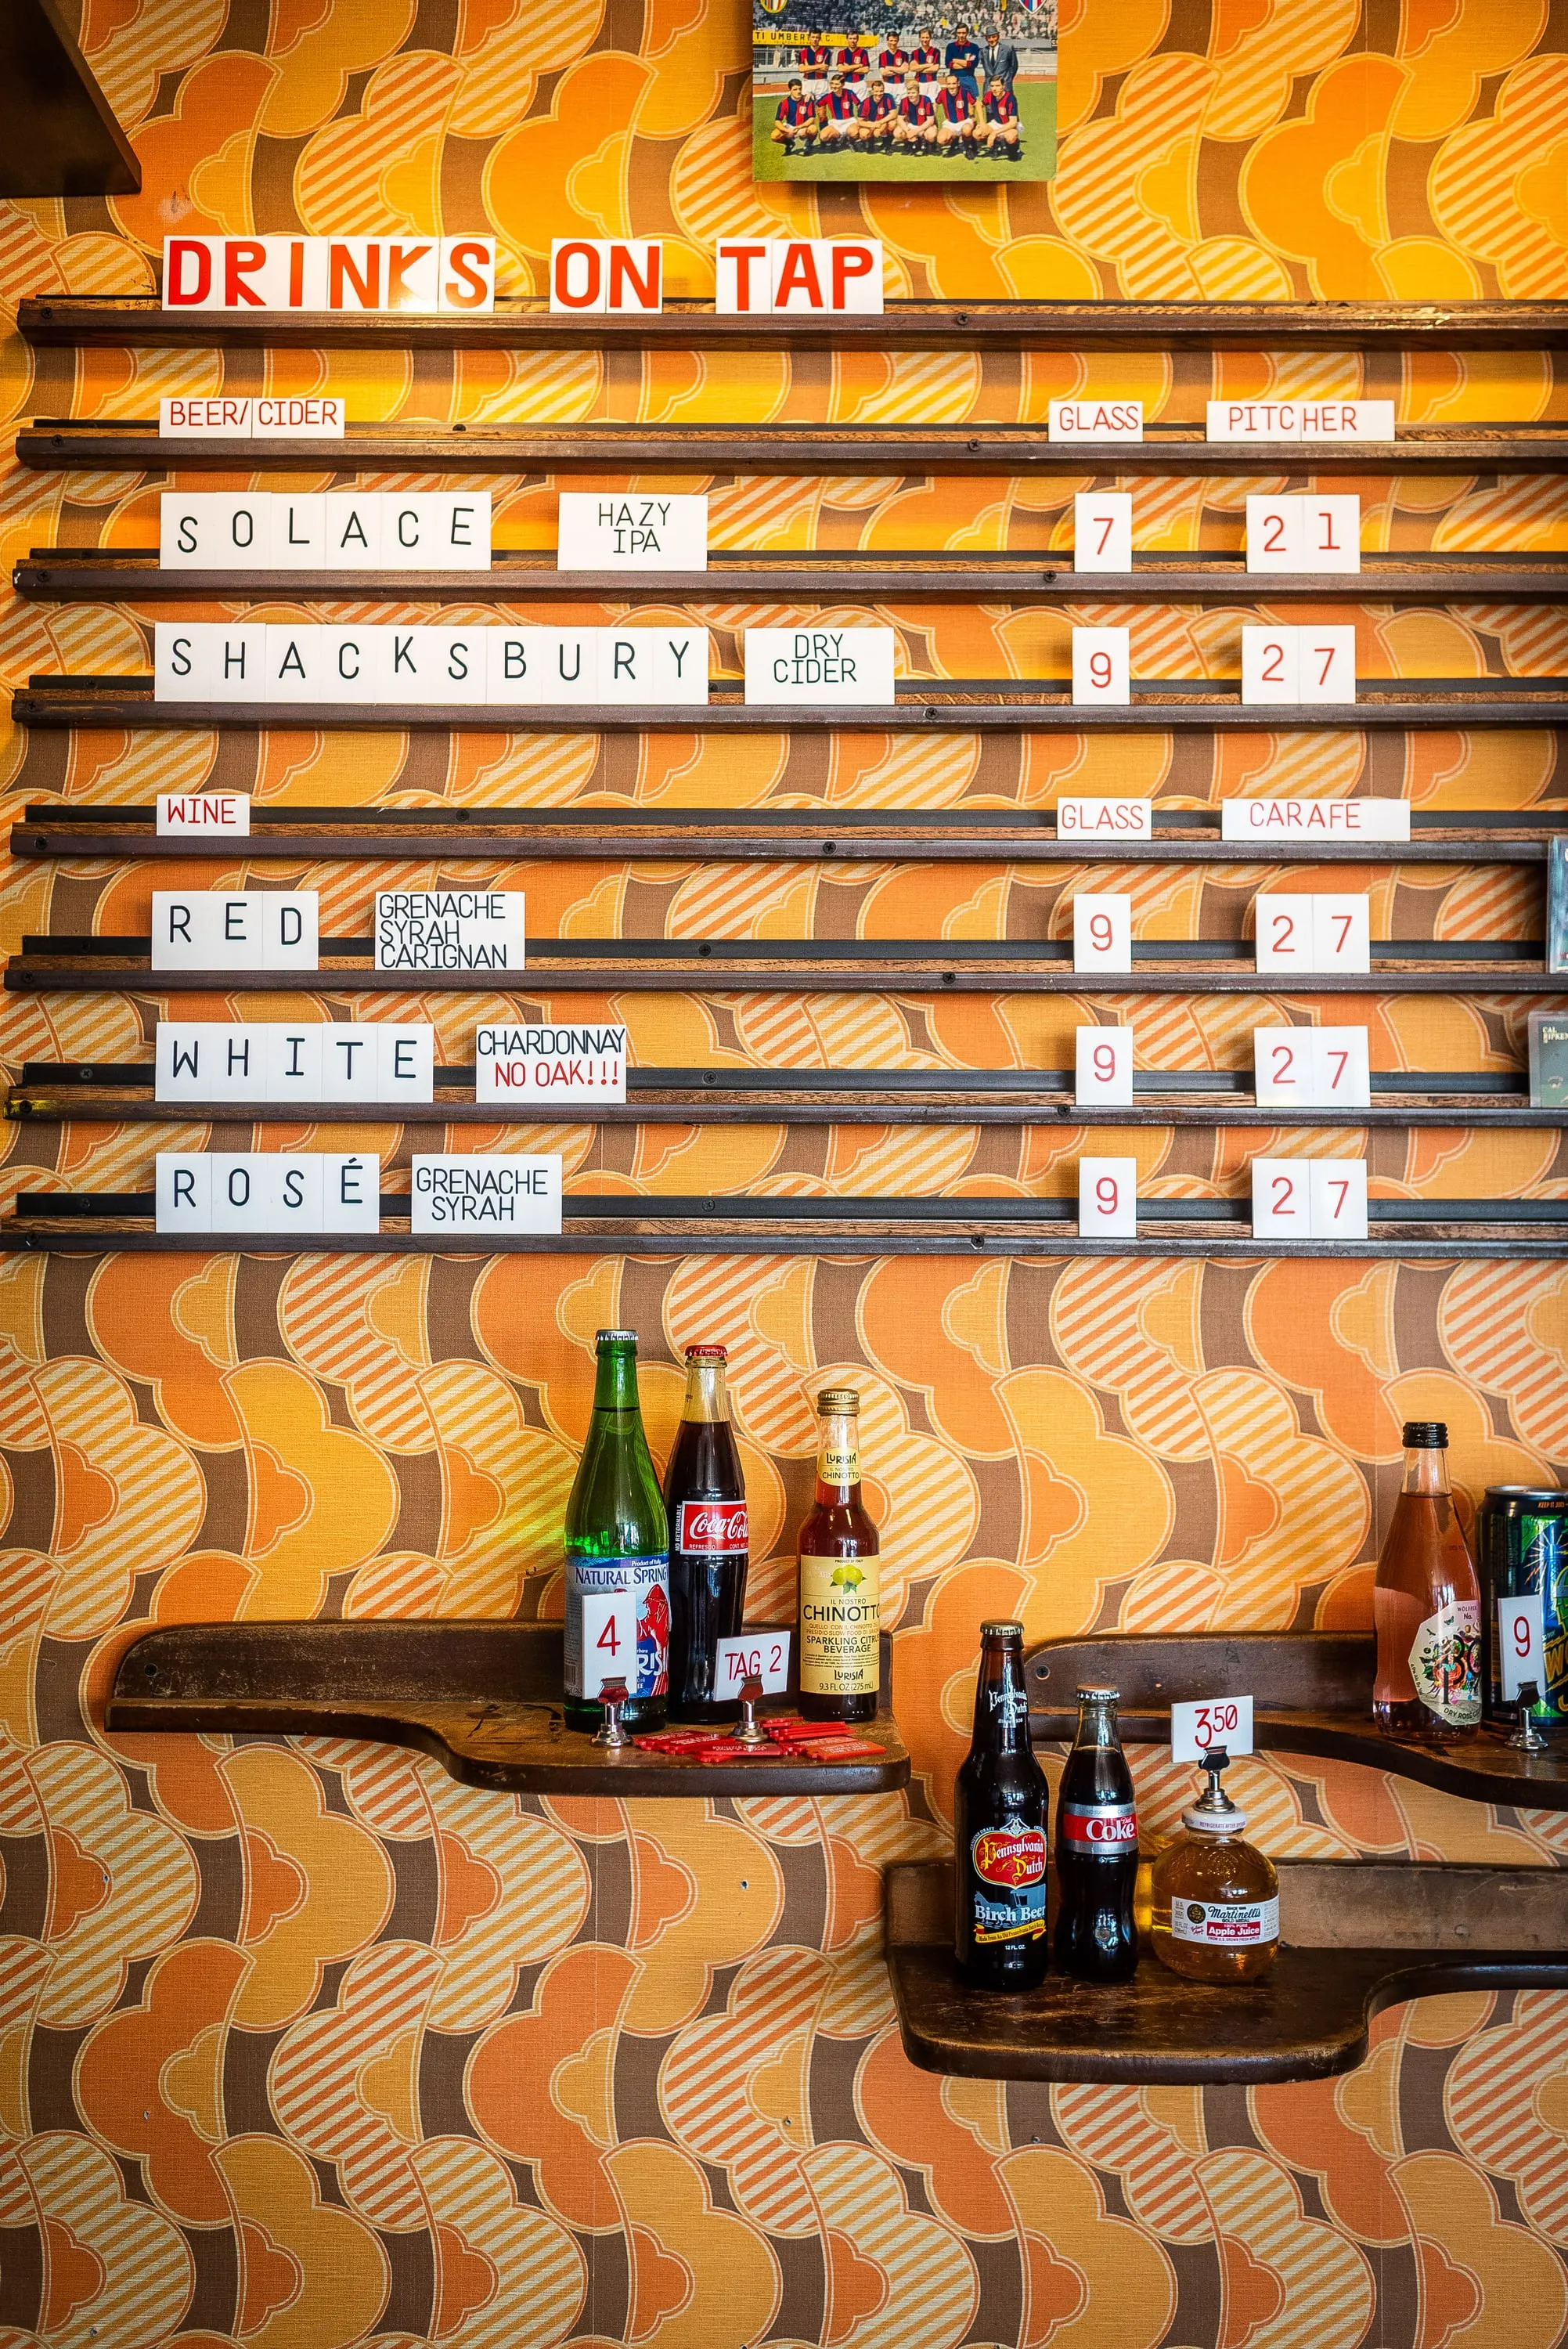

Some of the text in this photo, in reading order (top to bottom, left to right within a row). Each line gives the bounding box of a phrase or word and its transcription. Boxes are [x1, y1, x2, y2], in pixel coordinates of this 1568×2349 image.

[168, 239, 874, 311] DRINKS ON TAP
[1059, 406, 1139, 431] GLASS
[1229, 406, 1357, 432] PITCHER
[598, 502, 672, 528] HAZY
[177, 507, 474, 554] SOLACE
[612, 528, 661, 554] IPA
[1093, 517, 1114, 556] 7
[1263, 511, 1342, 553] 21
[171, 635, 690, 682] SHACKSBURY
[794, 633, 844, 659] DRY
[773, 657, 858, 684] CIDER
[1090, 651, 1112, 689] 9
[1261, 644, 1336, 686] 27
[168, 798, 236, 824] WINE
[1062, 804, 1144, 830] GLASS
[1249, 802, 1361, 829] CARAFE
[378, 893, 506, 919] GRENACHE
[169, 902, 303, 946] RED
[379, 919, 460, 944] SYRAH
[1089, 913, 1113, 951] 9
[1271, 915, 1354, 954] 27
[380, 944, 507, 969] CARIGNAN
[478, 1028, 625, 1056] CHARDONNAY
[172, 1037, 417, 1081] WHITE
[1093, 1044, 1116, 1083] 9
[1271, 1045, 1349, 1089] 27
[495, 1059, 619, 1088] NO OAK!!!
[174, 1156, 363, 1208] ROSÉ
[416, 1167, 549, 1196] GRENACHE
[431, 1195, 515, 1221] SYRAH
[1095, 1177, 1118, 1215] 9
[1271, 1177, 1350, 1219] 27
[575, 1567, 631, 1586] NATURAL
[596, 1615, 622, 1657] 4
[806, 1635, 857, 1645] SPARKLING
[824, 1644, 871, 1654] BEVERAGE
[1513, 1615, 1531, 1658] 9
[724, 1650, 761, 1680] TAG
[769, 1644, 782, 1672] 2
[834, 1669, 863, 1680] LURISIA
[1444, 1707, 1458, 1718] DRY
[1086, 1819, 1134, 1841] Coke
[982, 1838, 1044, 1871] Pennsylvania
[1011, 1855, 1043, 1879] Dutch
[975, 1905, 1046, 1921] Birch Beer
[1208, 1926, 1235, 1936] Apple
[1237, 1927, 1260, 1936] Juice
